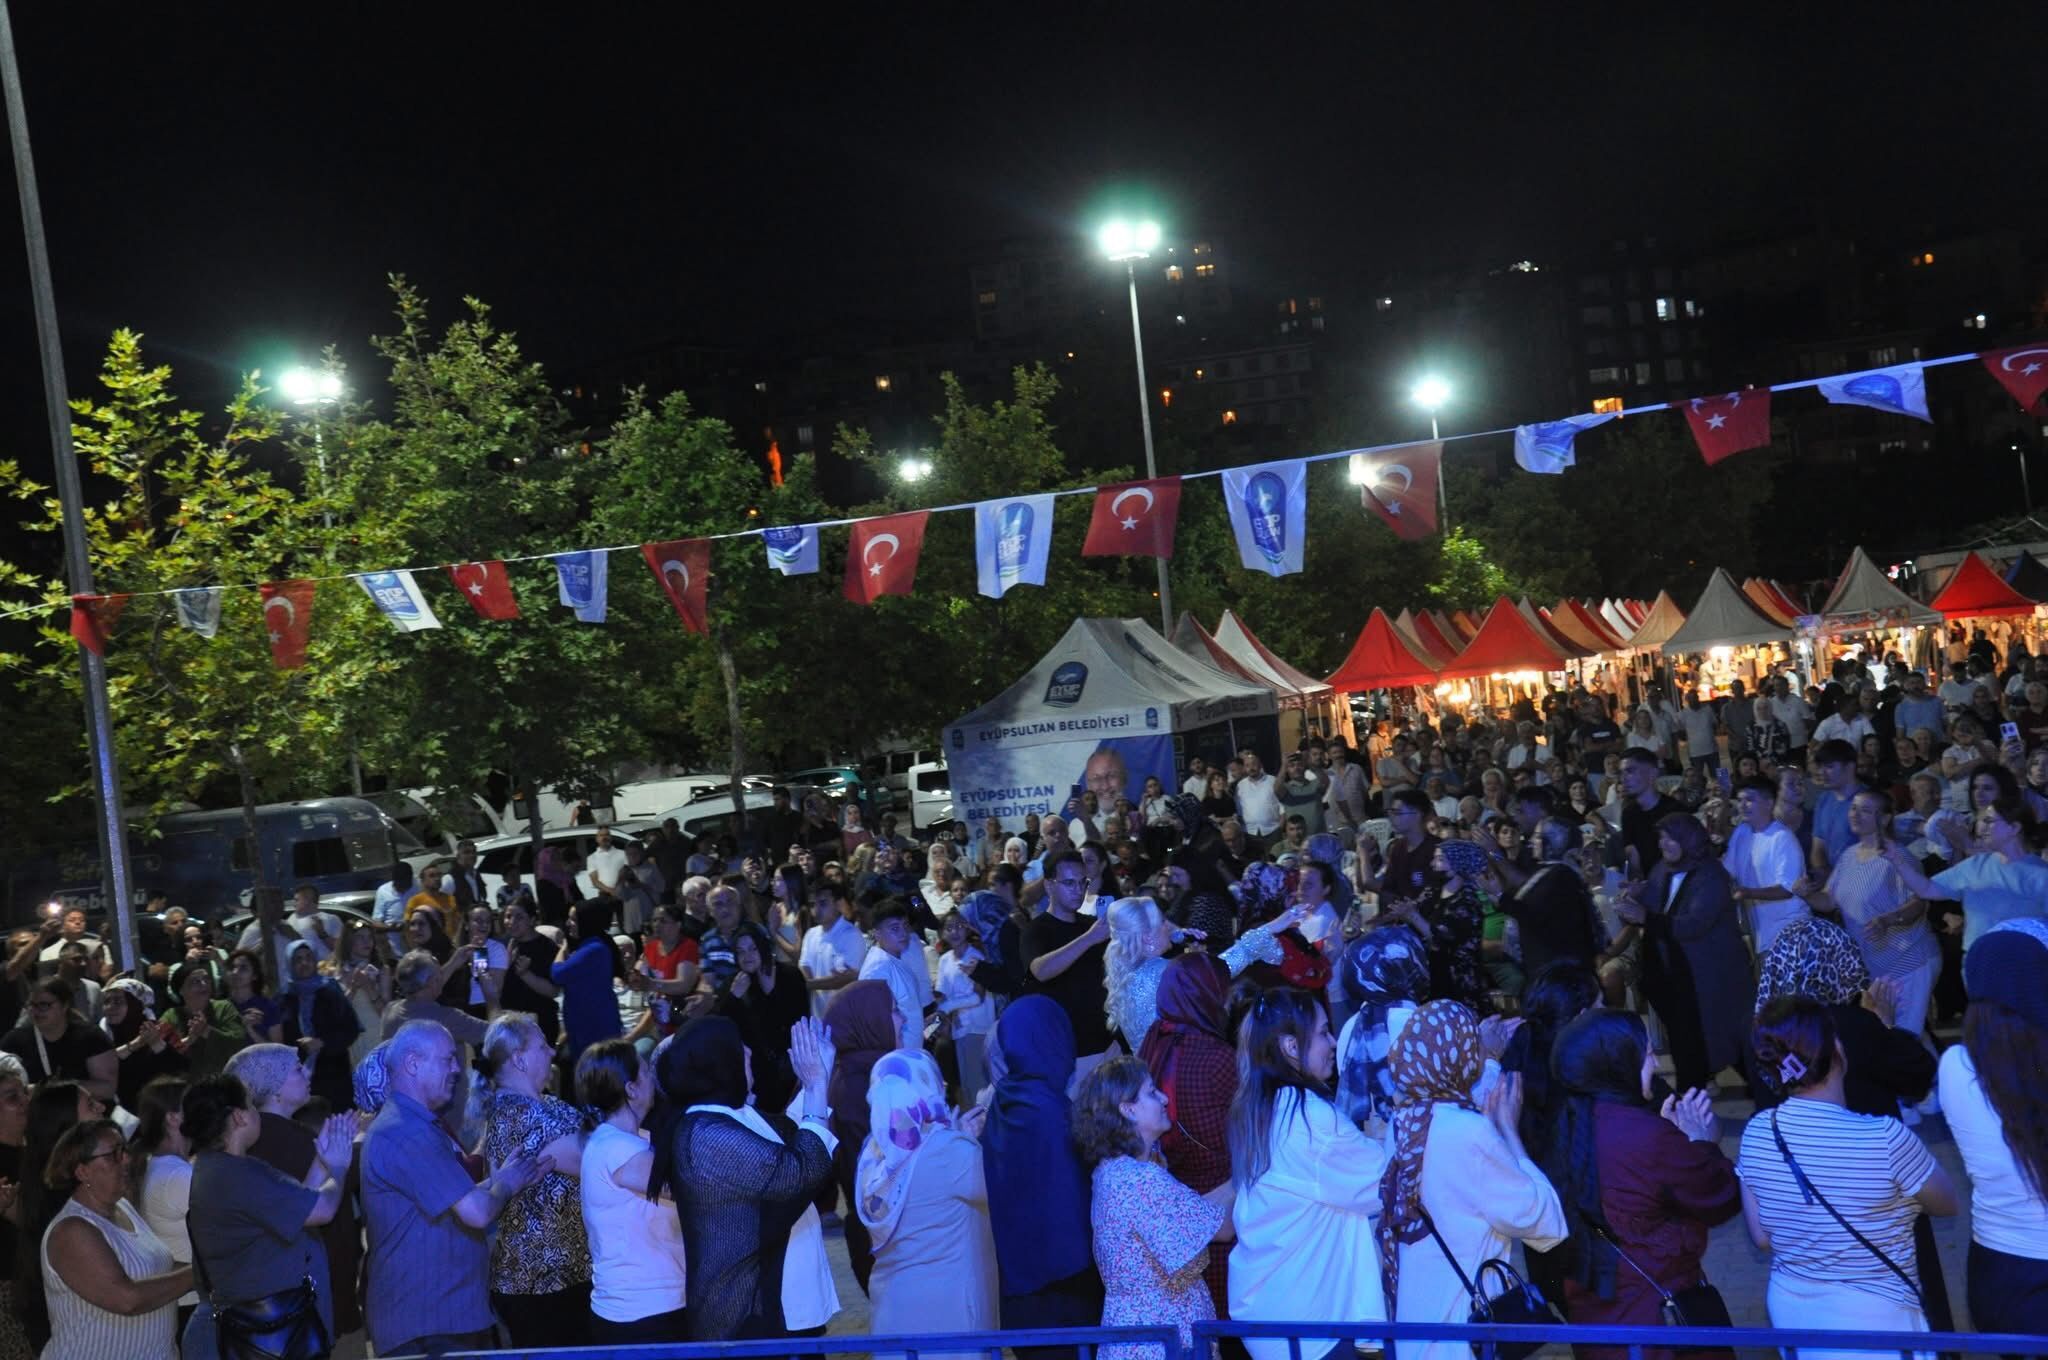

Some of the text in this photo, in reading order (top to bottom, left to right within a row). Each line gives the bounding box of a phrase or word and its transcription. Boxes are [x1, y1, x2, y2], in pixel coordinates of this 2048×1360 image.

[980, 722, 1055, 741] EYÜPSULTAN
[1059, 714, 1129, 732] BELEDİYESİ
[960, 785, 1055, 803] EYÜPSULTAN
[967, 800, 1050, 820] BELEDİYESİ
